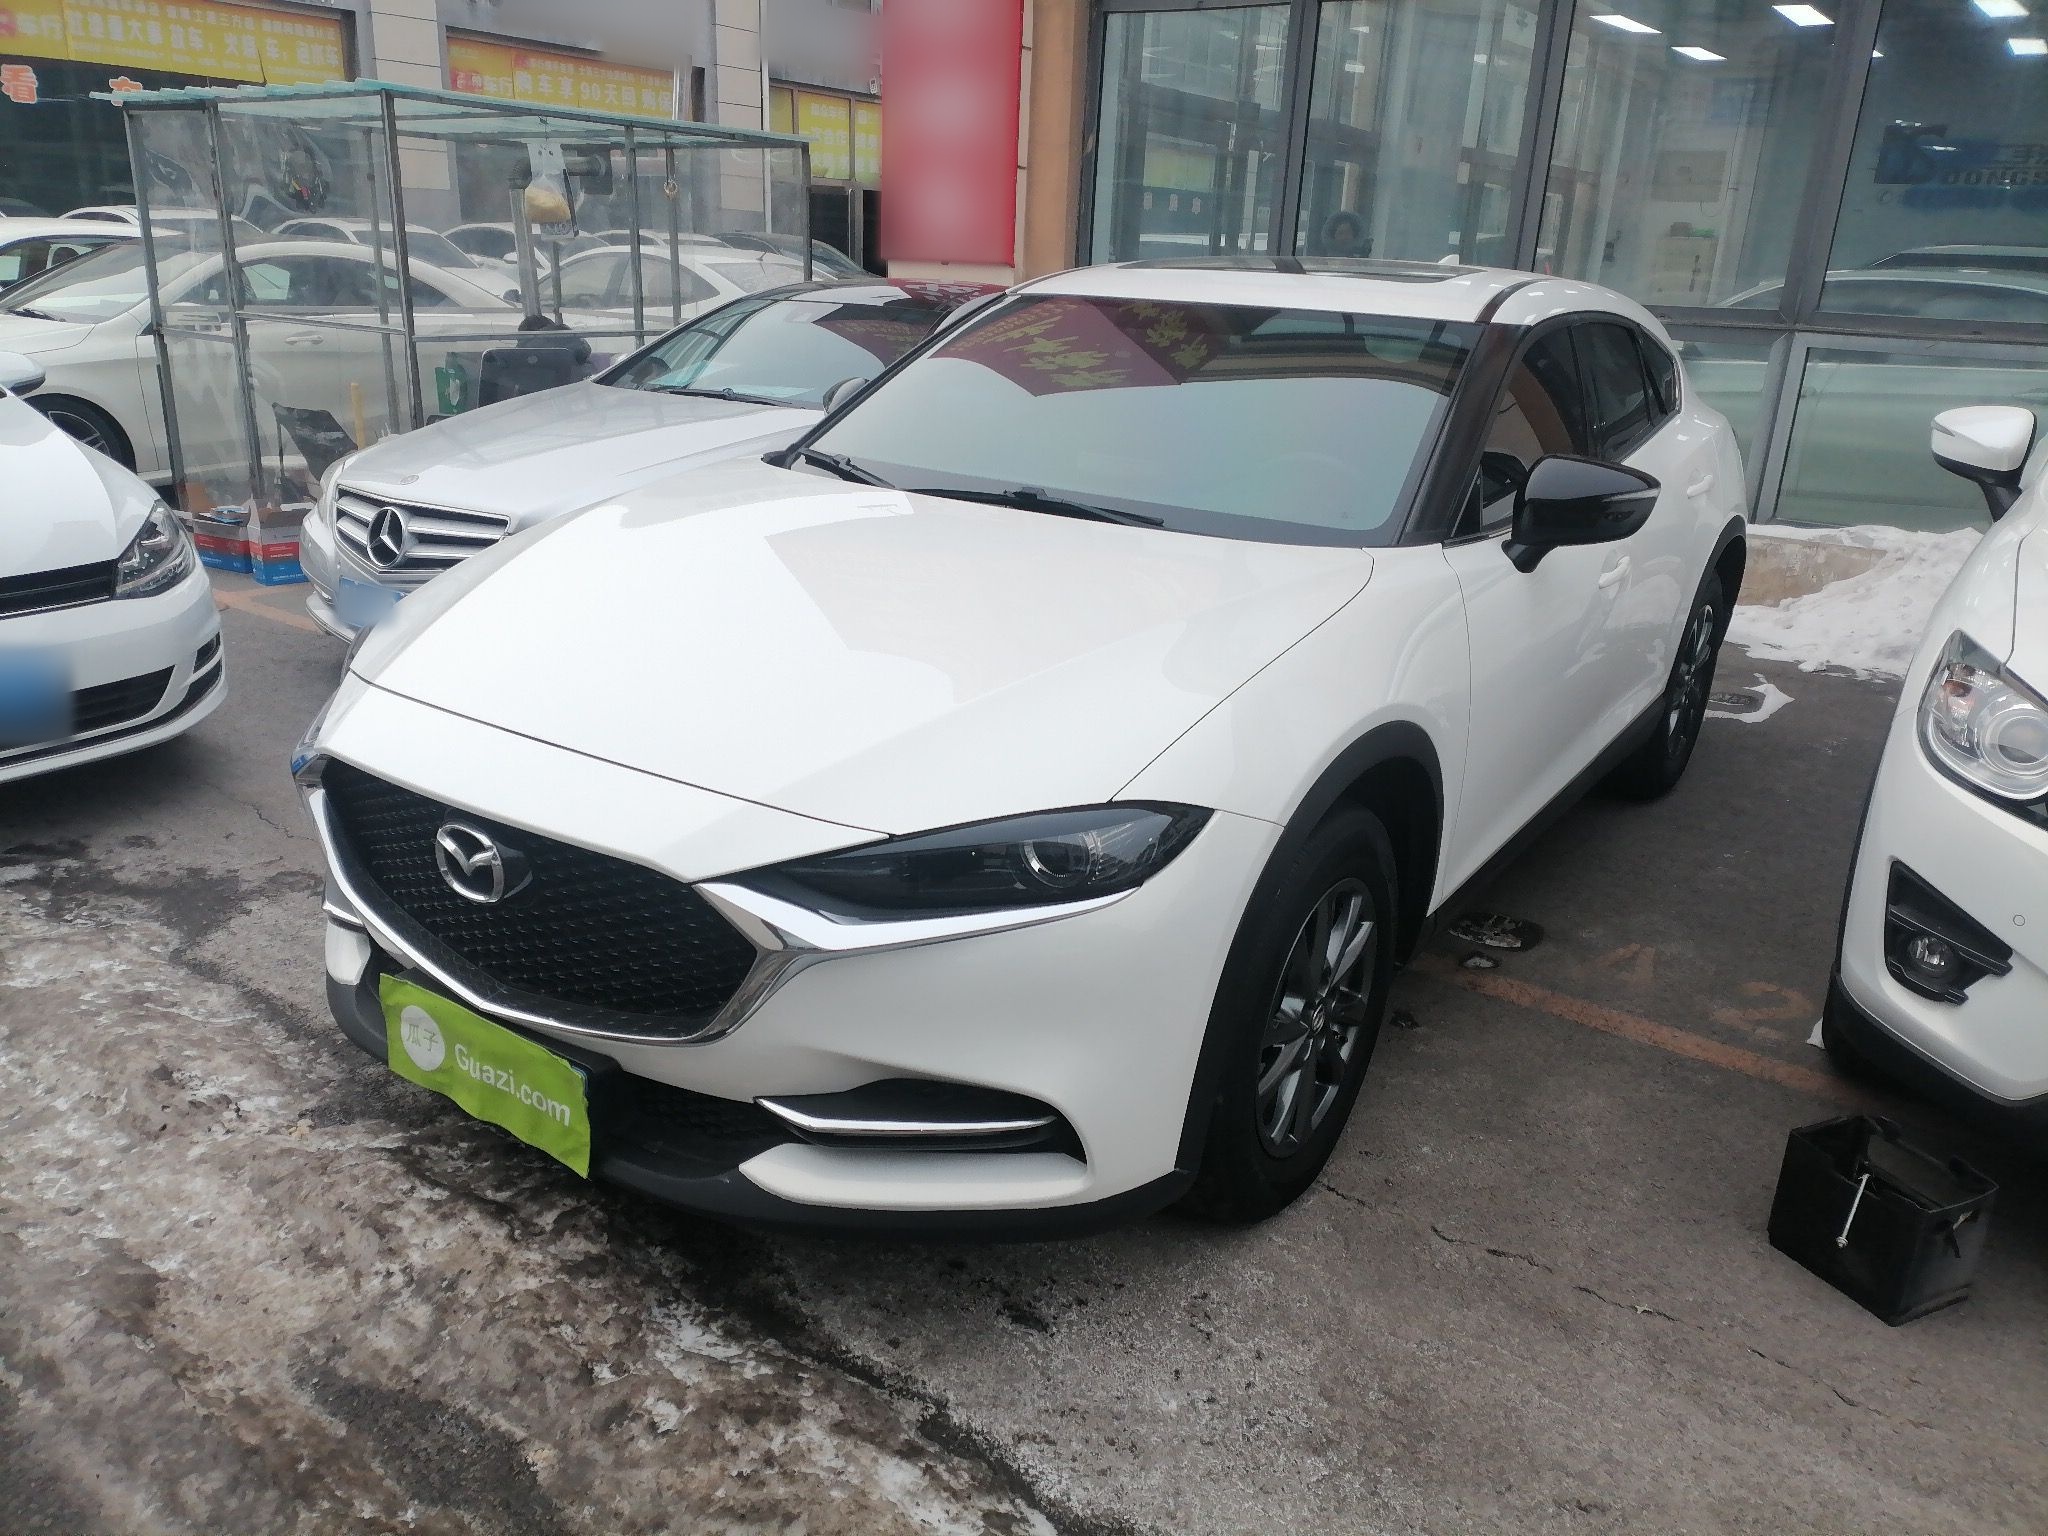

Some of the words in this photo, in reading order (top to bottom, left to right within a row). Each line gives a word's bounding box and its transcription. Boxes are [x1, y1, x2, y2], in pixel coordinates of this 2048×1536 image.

[0, 63, 37, 104] 看
[406, 1023, 439, 1052] 瓜子
[454, 1043, 571, 1127] Guazi.com
